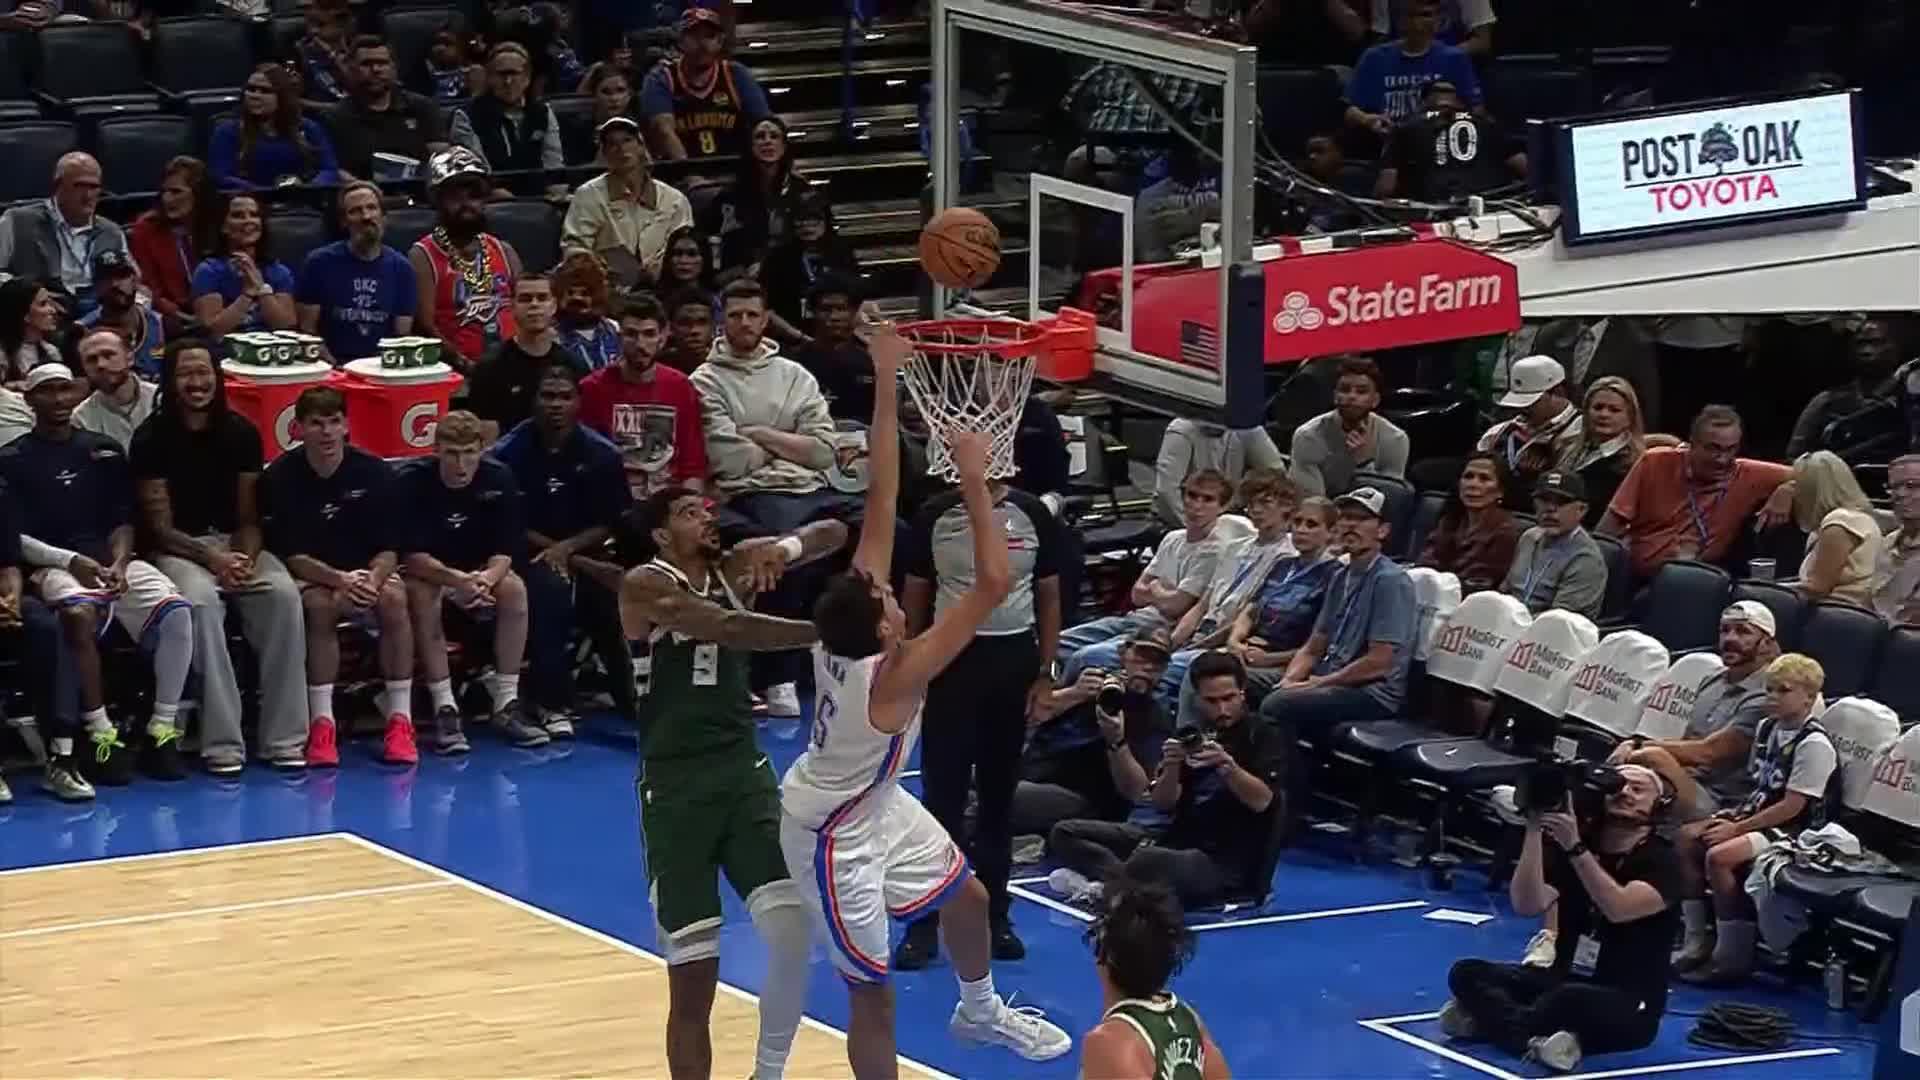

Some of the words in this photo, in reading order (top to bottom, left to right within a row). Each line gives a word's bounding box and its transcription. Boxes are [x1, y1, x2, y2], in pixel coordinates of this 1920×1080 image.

[1622, 132, 1696, 182] POST
[1742, 119, 1803, 166] OAK
[1649, 174, 1779, 213] TOYOTA
[401, 403, 438, 448] G
